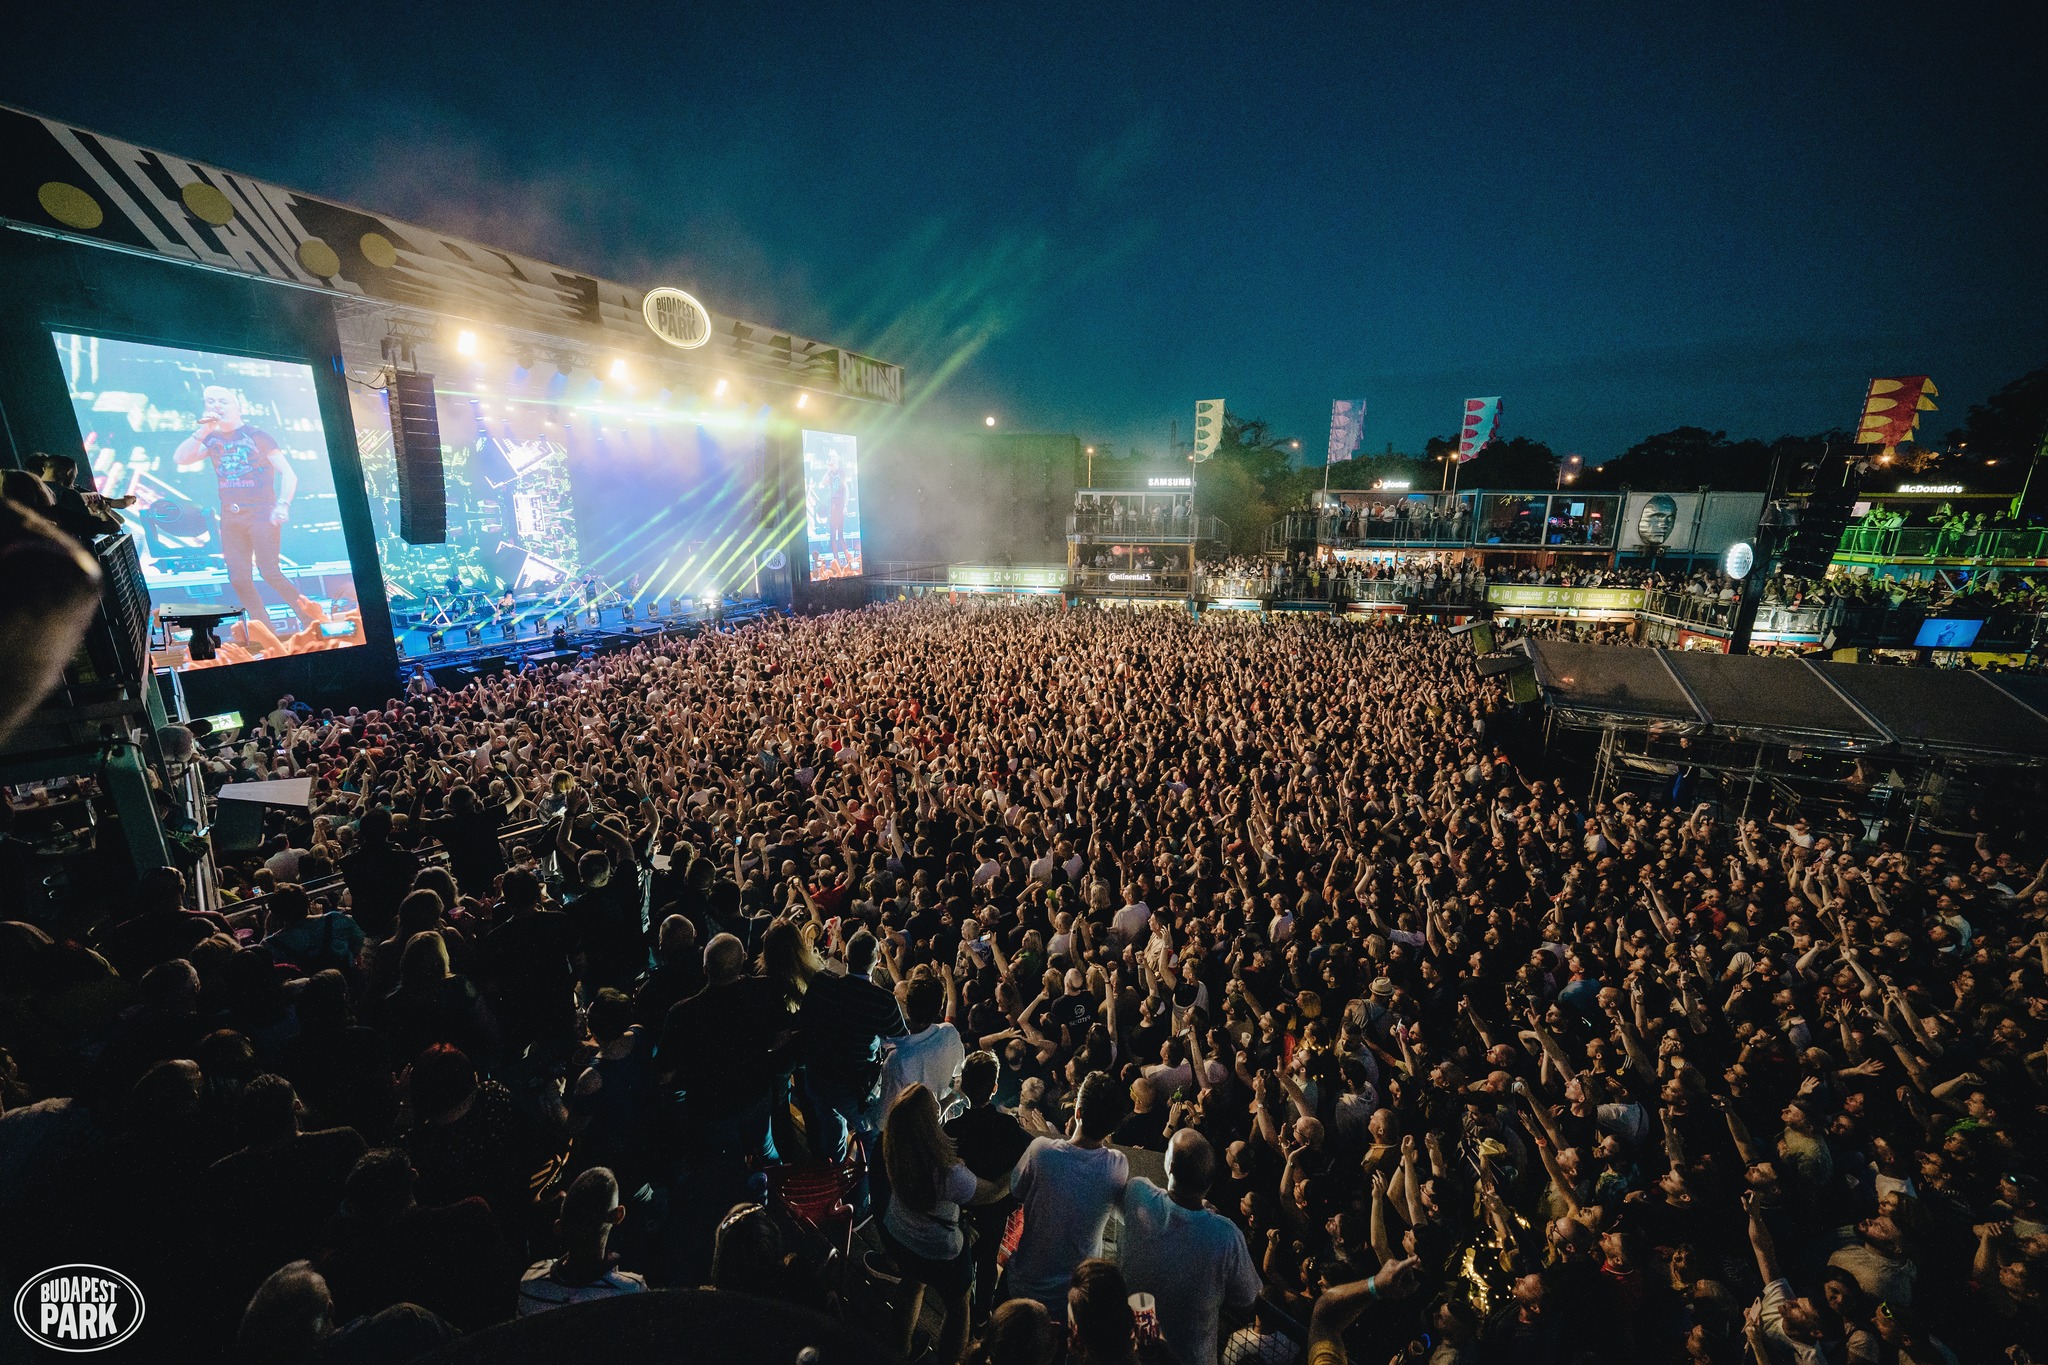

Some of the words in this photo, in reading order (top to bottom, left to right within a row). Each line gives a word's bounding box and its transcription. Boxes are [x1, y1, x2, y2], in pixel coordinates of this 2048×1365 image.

[656, 297, 696, 321] BUDAPEST
[657, 310, 697, 341] PARK
[1148, 478, 1191, 487] SAMSUNG
[1898, 484, 1963, 494] McDonald's
[1108, 572, 1146, 582] Continental
